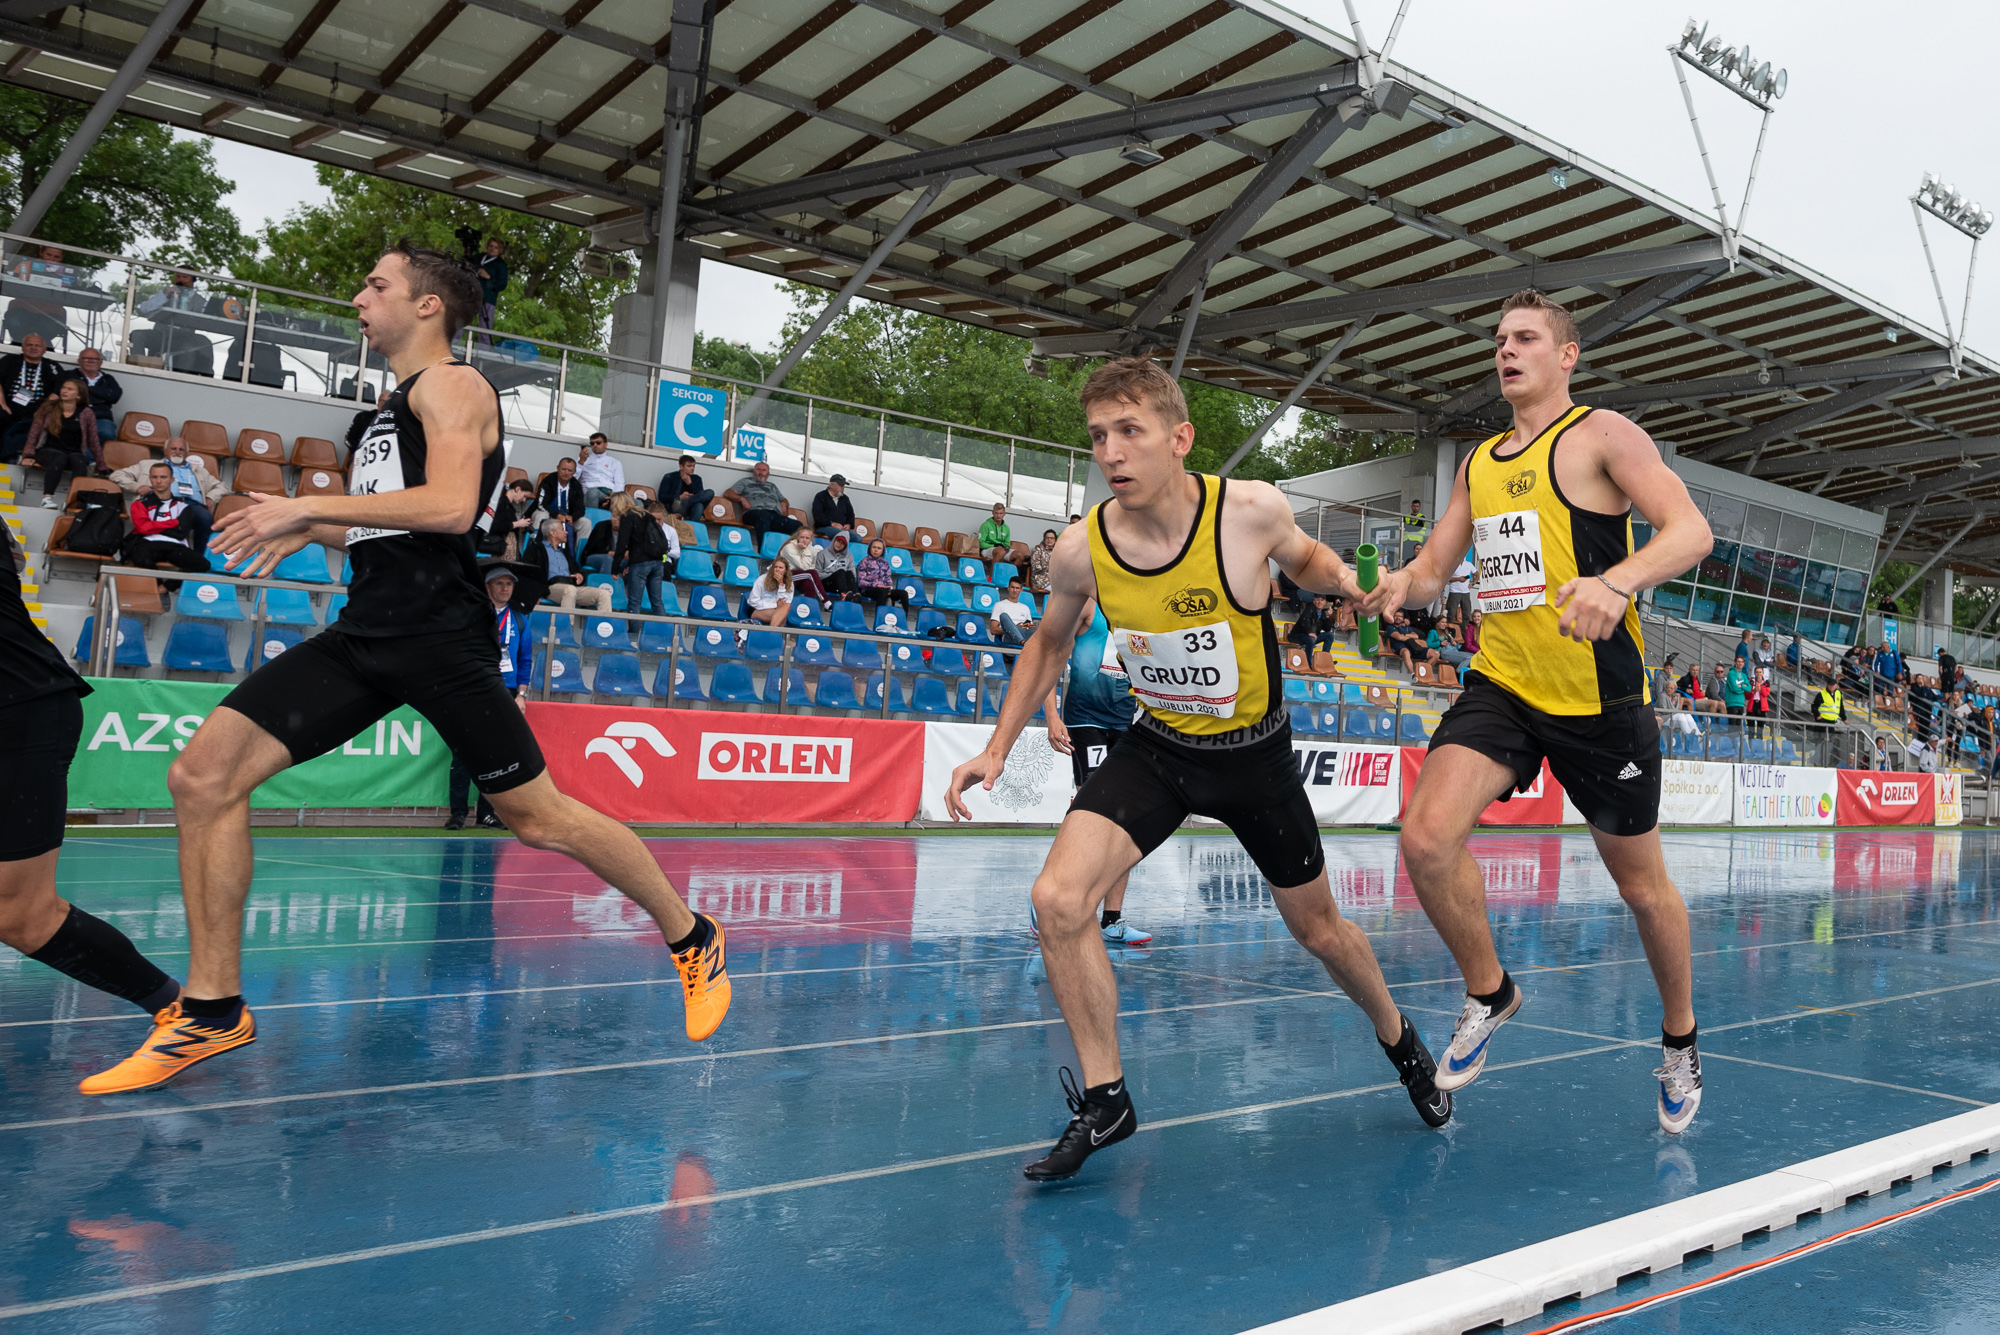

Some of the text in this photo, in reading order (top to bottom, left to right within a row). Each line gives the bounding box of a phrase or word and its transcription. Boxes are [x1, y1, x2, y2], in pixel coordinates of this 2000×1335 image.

[672, 388, 713, 403] SEKTOR
[673, 403, 709, 446] C
[739, 433, 763, 449] WC
[1499, 516, 1525, 538] 44
[1481, 551, 1540, 582] ĘGRZYN
[1177, 599, 1208, 614] OSA
[1503, 598, 1523, 609] 2021
[1183, 630, 1217, 653] 33
[1140, 665, 1221, 687] GRUZD
[1159, 700, 1220, 715] LUBLIN 2021
[1196, 728, 1244, 747] PRO
[709, 740, 842, 775] ORLEN
[1092, 747, 1103, 765] 7
[478, 762, 520, 780] COLO
[1618, 770, 1643, 780] adidas
[1665, 761, 1705, 775] PZLA 100
[1664, 779, 1722, 797] Spółka z o.o.
[1775, 770, 1786, 788] for
[1884, 785, 1916, 802] ORLEN
[1795, 796, 1816, 818] KIDS
[1937, 806, 1958, 820] PZLA
